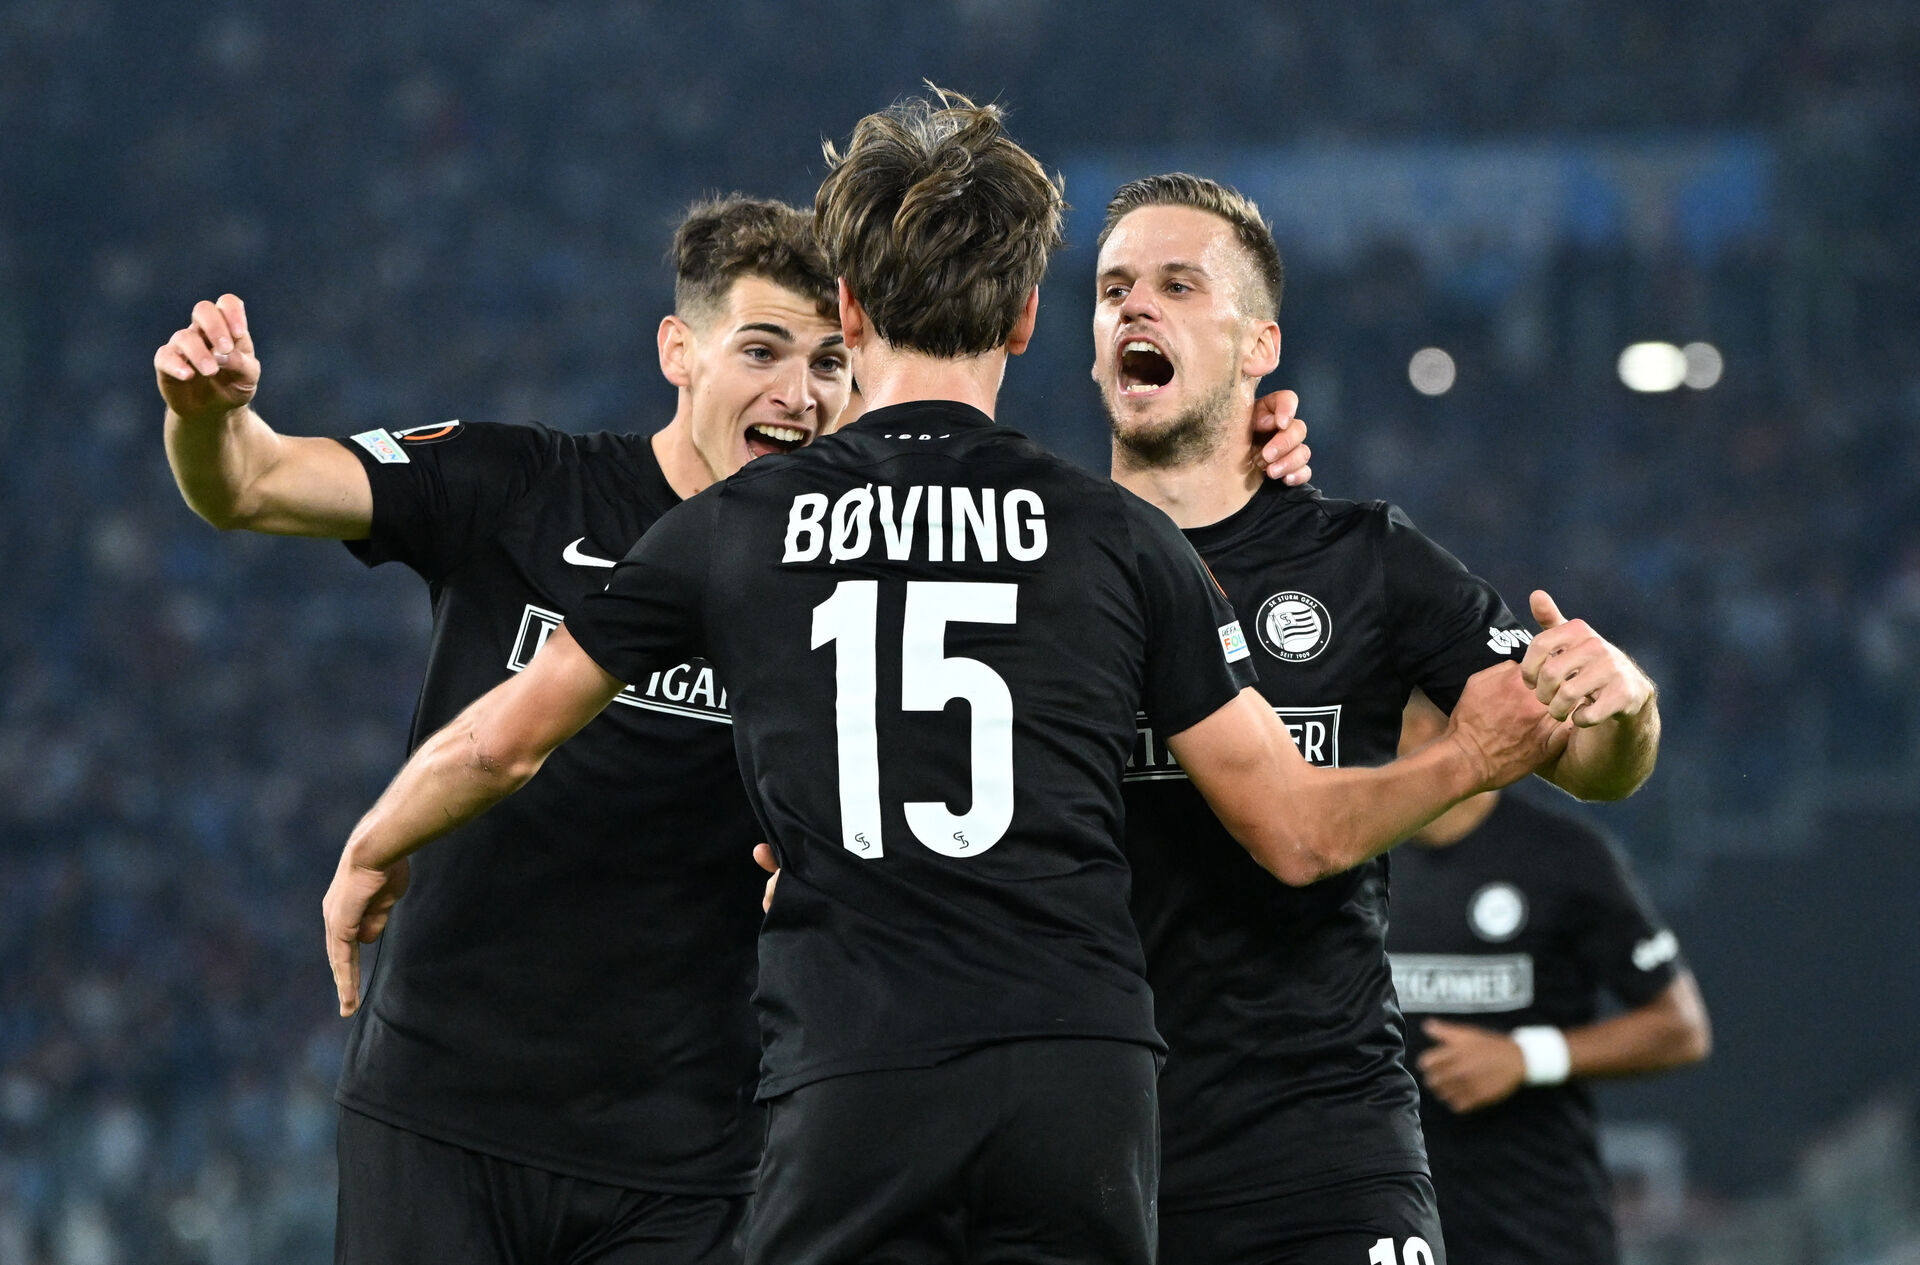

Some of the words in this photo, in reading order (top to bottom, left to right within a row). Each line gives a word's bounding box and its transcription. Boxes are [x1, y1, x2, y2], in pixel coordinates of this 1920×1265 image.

[782, 483, 1048, 564] BØVING
[1268, 599, 1277, 608] SK
[1277, 594, 1299, 603] STURM
[1300, 596, 1318, 609] GRAZ
[1280, 651, 1294, 659] SEIT
[1295, 651, 1310, 660] 1909
[811, 580, 1018, 859] 15
